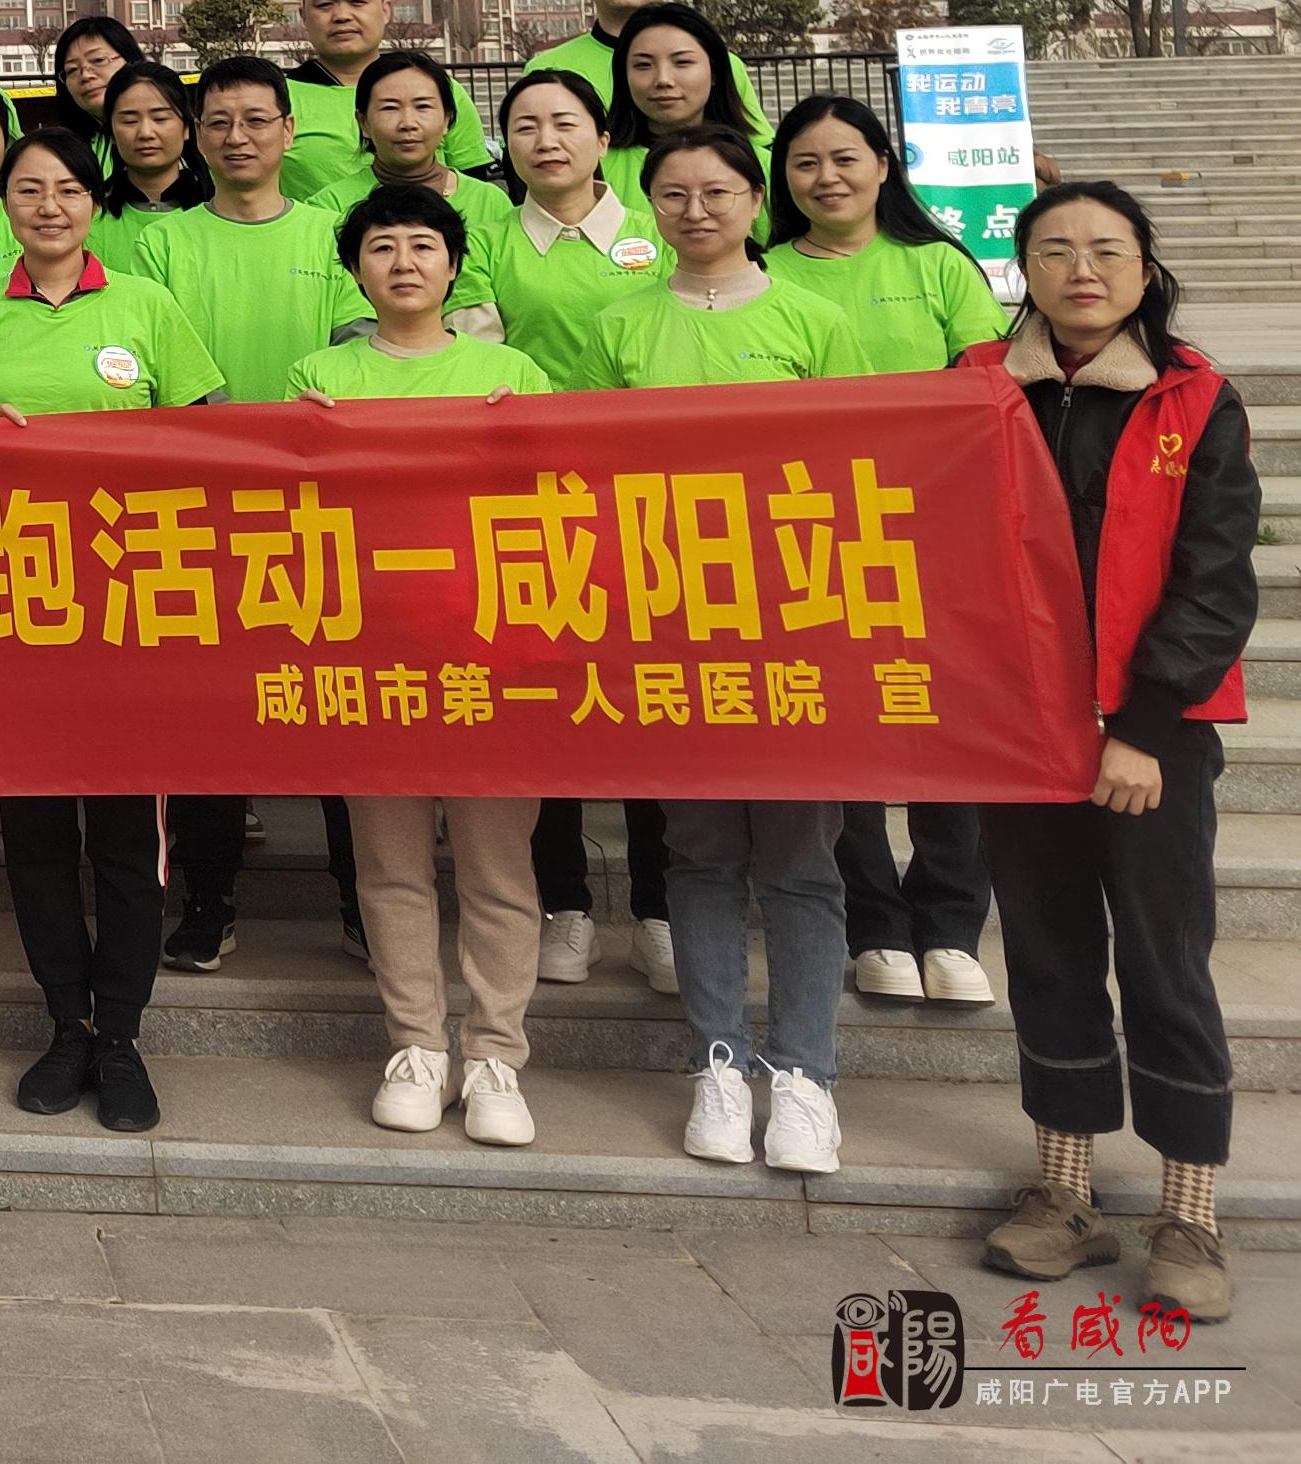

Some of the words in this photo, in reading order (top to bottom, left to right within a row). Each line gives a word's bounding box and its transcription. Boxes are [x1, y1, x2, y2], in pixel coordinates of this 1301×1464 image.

[906, 72, 986, 94] 我运动
[947, 147, 1021, 167] 咸阳站
[255, 660, 827, 727] 咸阳市第一人民医院
[873, 659, 940, 725] 宣
